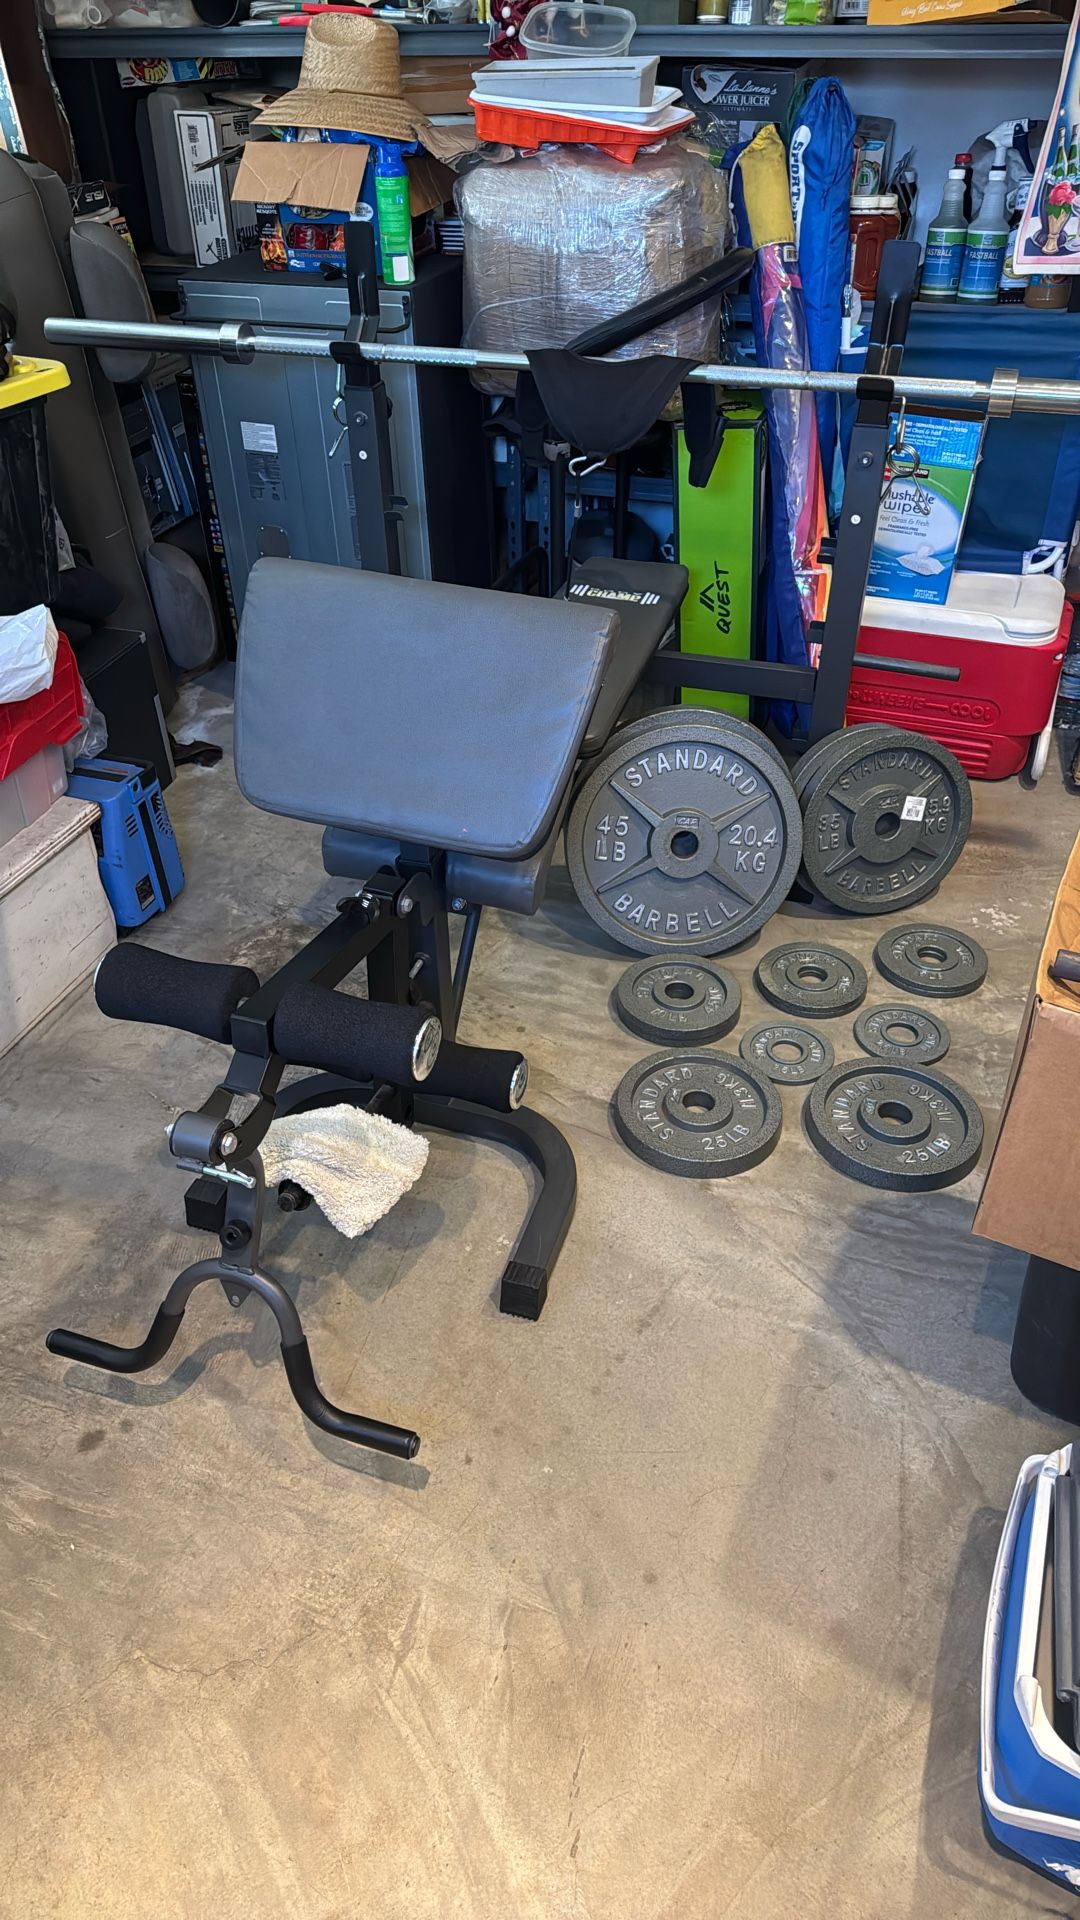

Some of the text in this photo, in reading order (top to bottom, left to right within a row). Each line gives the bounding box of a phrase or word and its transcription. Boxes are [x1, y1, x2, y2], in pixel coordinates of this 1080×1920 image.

[712, 94, 770, 107] OWER JUICER
[969, 251, 999, 260] FASTBALL
[888, 488, 935, 504] lushle
[716, 561, 732, 635] QUEST
[625, 748, 758, 796] STANDARD
[837, 751, 932, 790] STANDARD
[927, 795, 952, 815] 5.9
[596, 814, 630, 837] 45
[728, 824, 779, 847] 20.4
[924, 816, 948, 836] KG
[594, 839, 627, 863] LB
[818, 833, 840, 852] LB
[734, 850, 767, 873] KG
[836, 861, 927, 895] BARBELL
[613, 893, 740, 934] BARBELL
[639, 1067, 693, 1140] STANDARD
[831, 1077, 885, 1151] STANDARD
[701, 1124, 750, 1150] 25LB
[901, 1137, 951, 1163] 25LB
